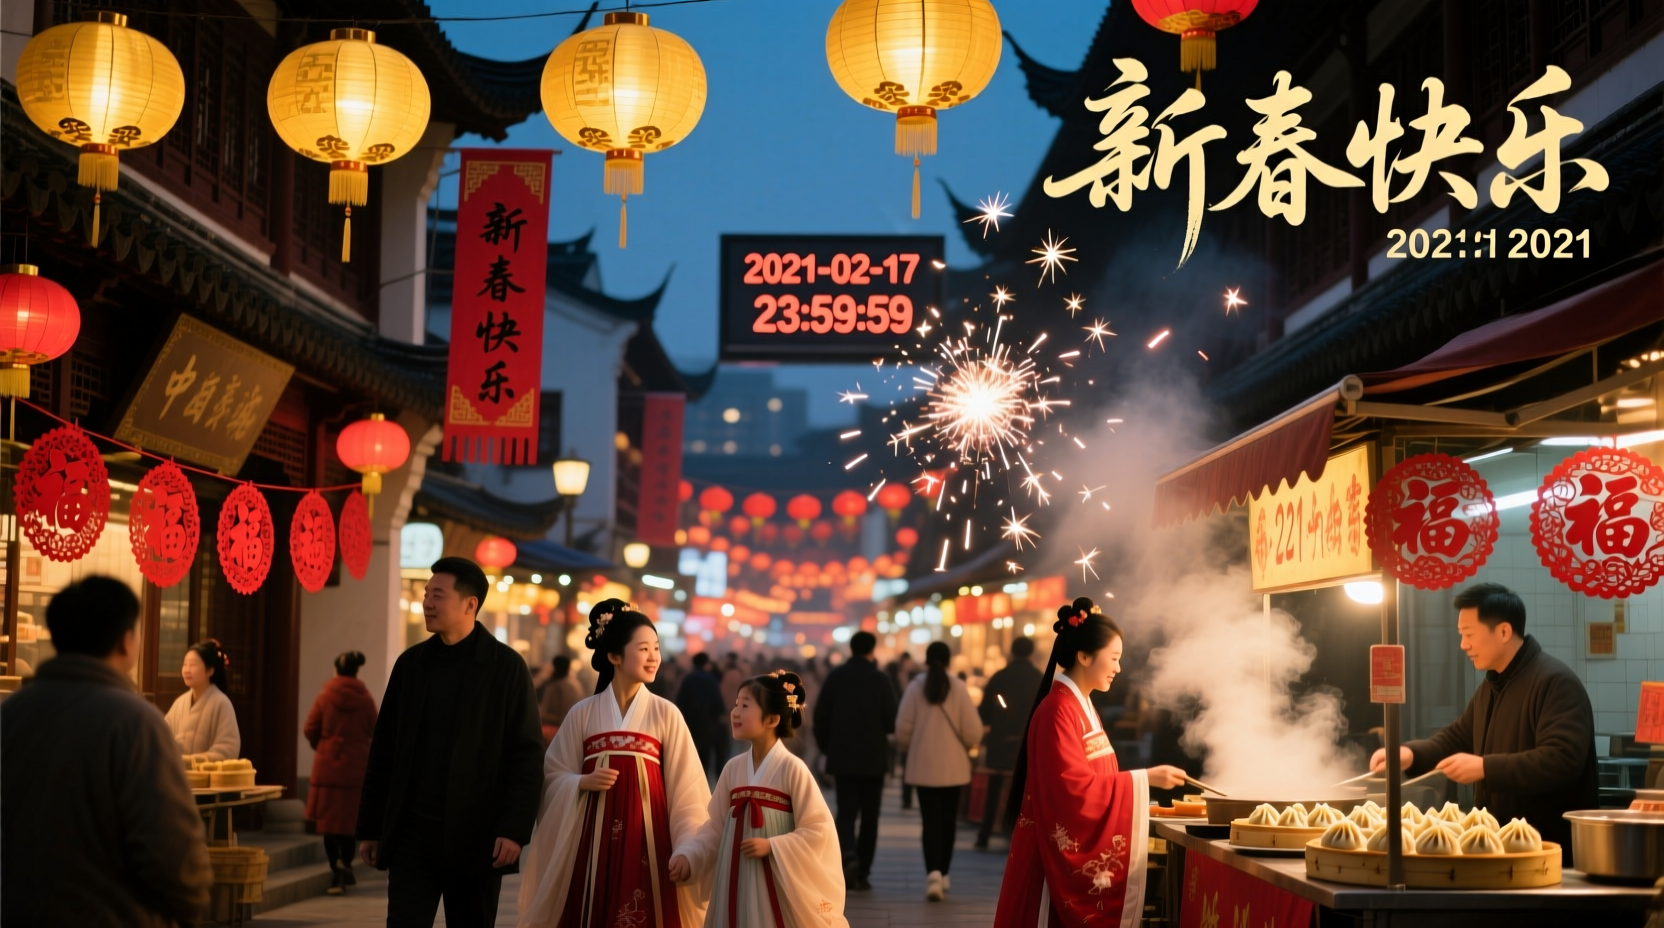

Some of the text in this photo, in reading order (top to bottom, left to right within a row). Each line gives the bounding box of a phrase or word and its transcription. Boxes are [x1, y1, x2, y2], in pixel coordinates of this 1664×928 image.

[475, 202, 528, 404] 新春快乐
[743, 252, 919, 285] 2021-02-17
[752, 294, 914, 334] 23:59:59
[230, 501, 264, 572] 福
[1392, 478, 1470, 558] 福
[1563, 473, 1650, 558] 福
